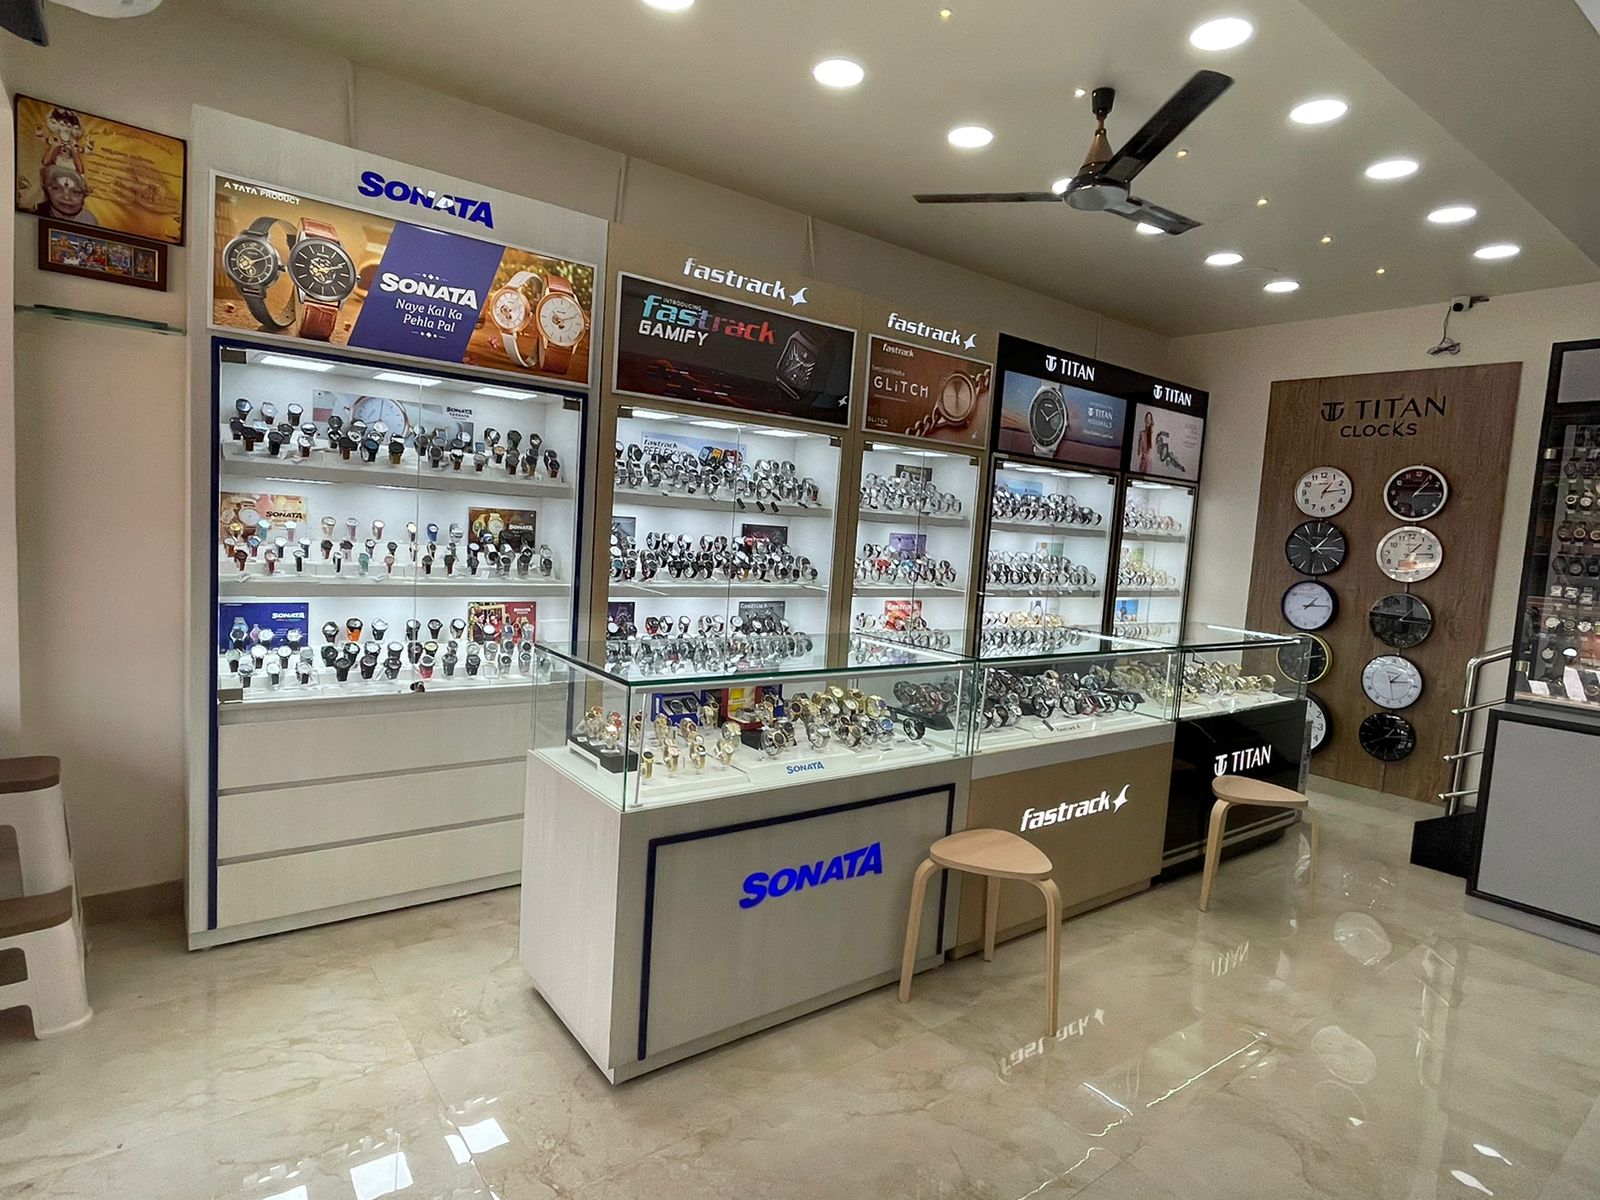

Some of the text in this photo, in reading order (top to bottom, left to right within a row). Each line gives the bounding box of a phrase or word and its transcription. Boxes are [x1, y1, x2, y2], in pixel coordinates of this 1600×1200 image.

[224, 181, 300, 205] A TATA PRODUCT
[357, 171, 494, 229] SONATA
[683, 257, 786, 300] fastrack
[379, 272, 478, 310] SONATA
[395, 299, 463, 321] Naye Kal Ka
[662, 297, 702, 312] INTRODUCING
[403, 313, 456, 333] Pehla Pal
[641, 294, 777, 346] fastrack
[887, 312, 961, 346] fastrack
[638, 319, 709, 347] GAMIFY
[882, 343, 914, 358] fastrack
[1060, 358, 1096, 382] TITAN
[1165, 387, 1193, 407] TITAN
[1355, 395, 1447, 420] TITAN
[1340, 420, 1418, 438] CLOCKS
[643, 439, 678, 449] fastrack
[265, 511, 303, 520] SONATA
[271, 611, 305, 620] SONATA
[1316, 710, 1322, 719] 2
[1317, 722, 1324, 731] 3
[1312, 734, 1319, 742] 4
[786, 761, 824, 775] SONATA
[1231, 744, 1272, 773] TITAN
[1020, 790, 1111, 832] fastrack
[738, 841, 883, 910] SONATA
